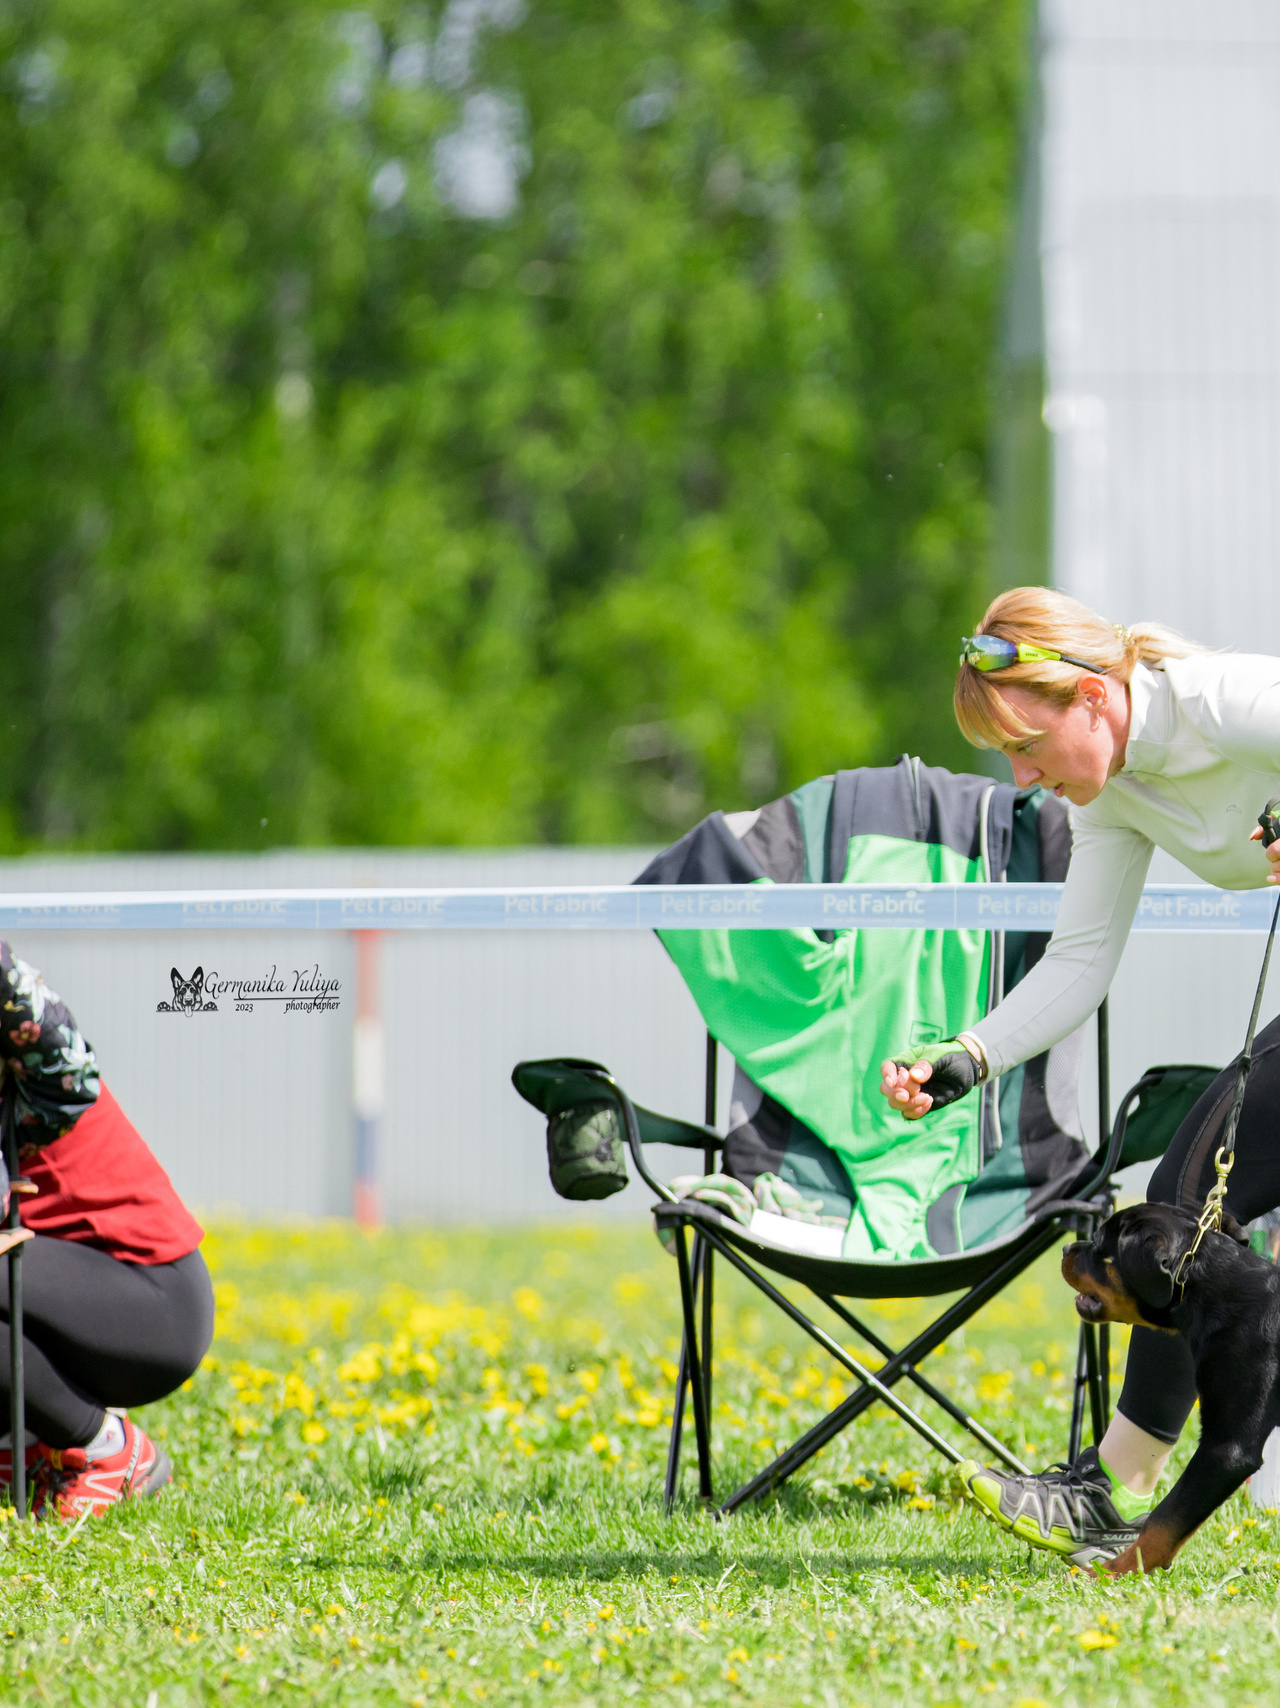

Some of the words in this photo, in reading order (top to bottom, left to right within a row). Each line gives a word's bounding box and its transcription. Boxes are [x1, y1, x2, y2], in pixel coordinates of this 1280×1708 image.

[823, 893, 857, 914] Pet
[860, 890, 925, 914] Fabric
[1015, 894, 1061, 915] Fabr
[1138, 896, 1173, 917] Pet
[1176, 894, 1242, 917] Fabric
[1101, 1533, 1140, 1541] SALOM
